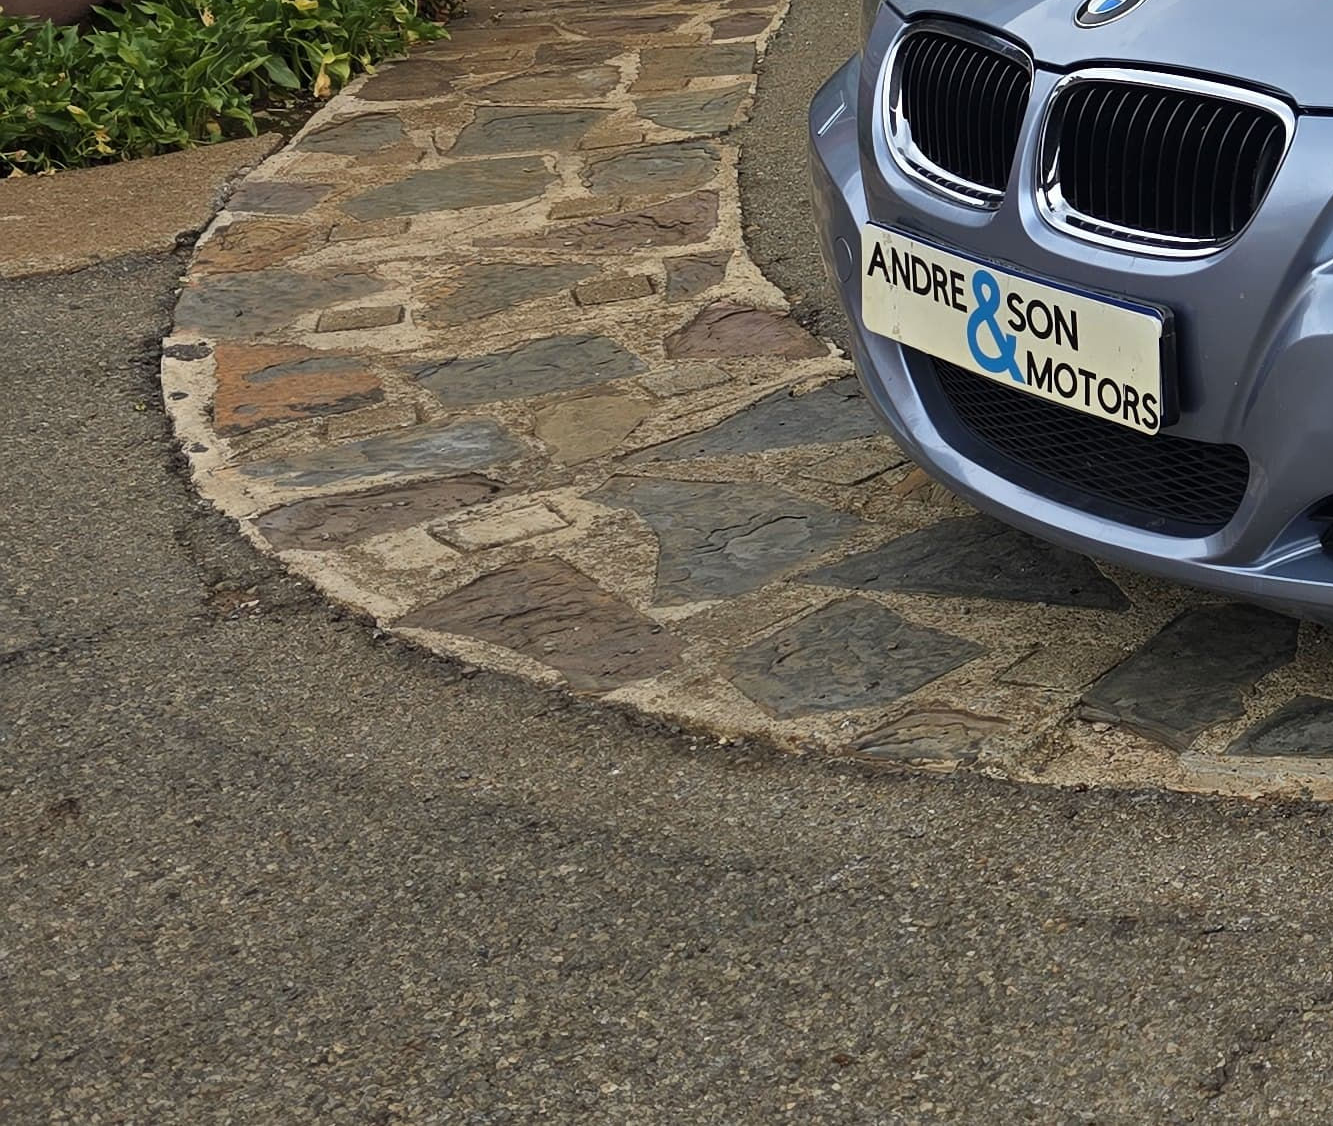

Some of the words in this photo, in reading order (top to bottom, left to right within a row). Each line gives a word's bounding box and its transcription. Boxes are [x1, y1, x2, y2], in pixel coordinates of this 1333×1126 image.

[867, 241, 968, 314] ANDRE
[966, 269, 1026, 384] &
[1006, 292, 1079, 351] SON
[1026, 350, 1159, 431] MOTORS
